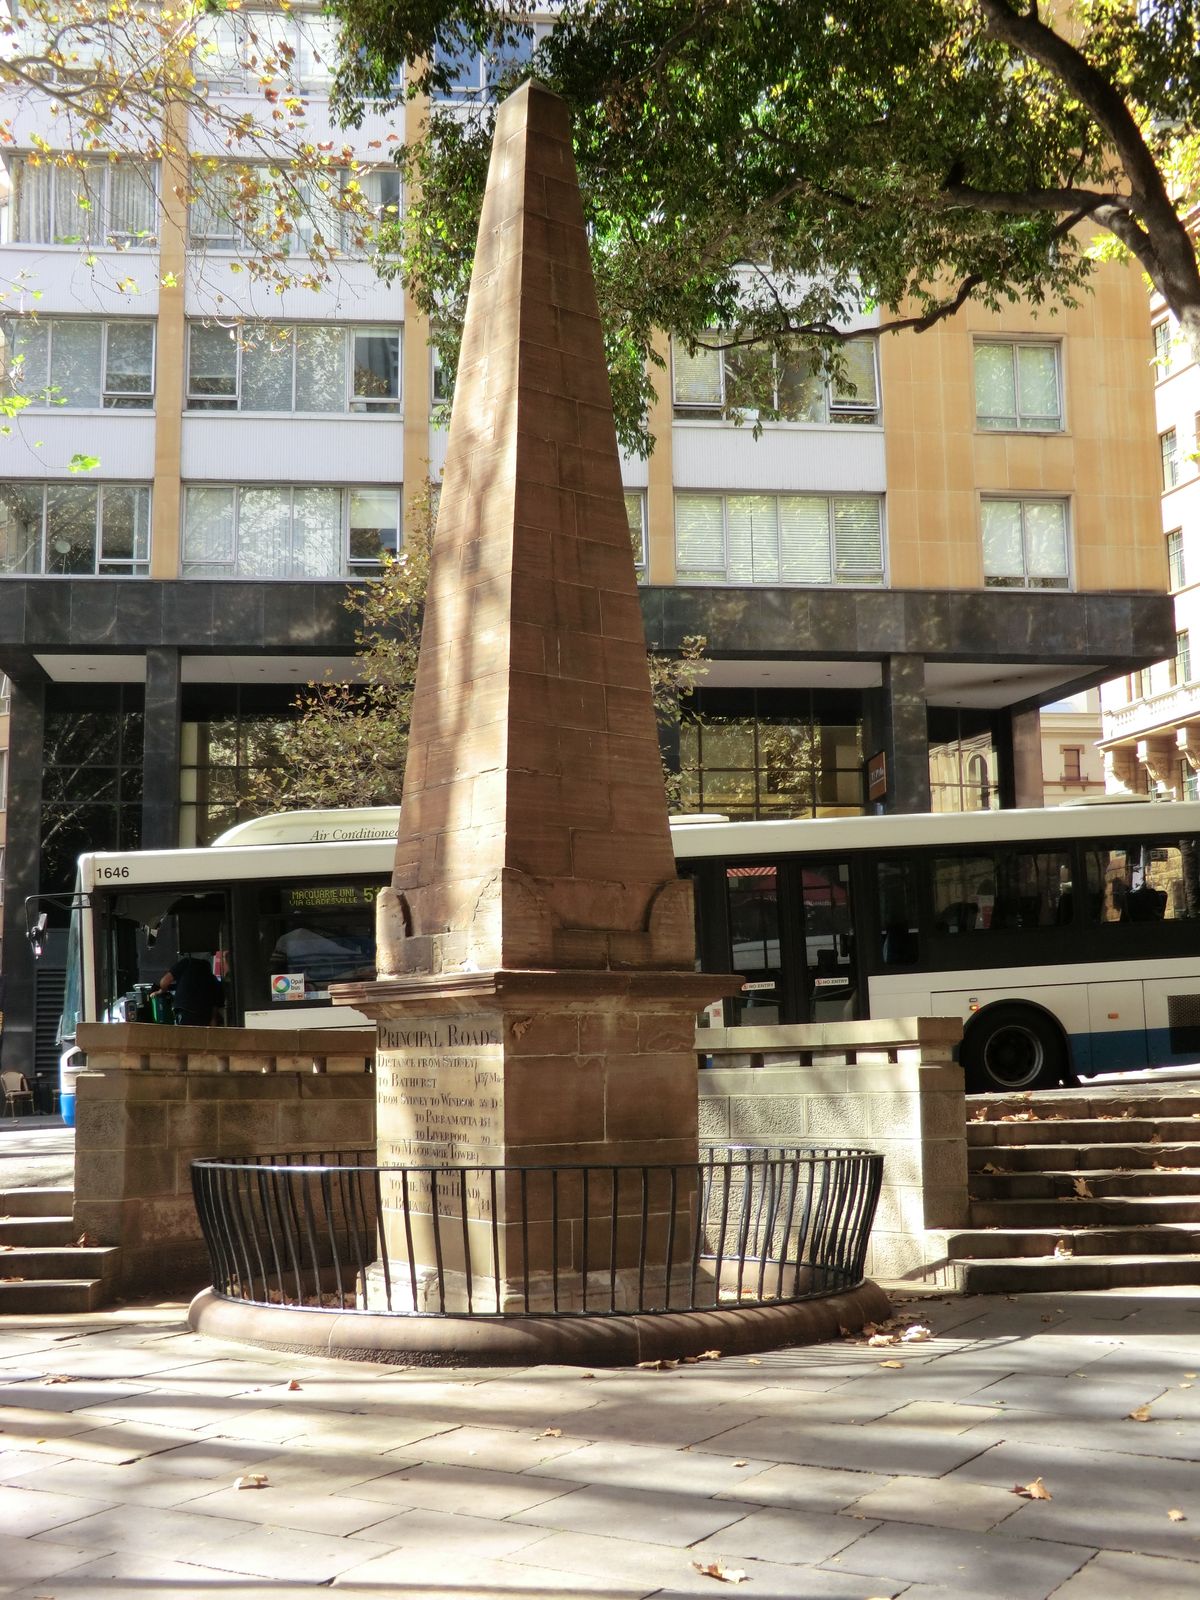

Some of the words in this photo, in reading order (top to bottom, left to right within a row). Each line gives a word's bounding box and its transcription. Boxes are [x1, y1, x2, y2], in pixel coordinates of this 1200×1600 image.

[309, 829, 330, 841] Air
[96, 866, 130, 879] 1646
[291, 889, 338, 900] MACQUARIE
[377, 1026, 443, 1048] PRINCIPAL
[377, 1053, 416, 1067] DISTANCE
[417, 1057, 441, 1068] FROM
[442, 1055, 474, 1068] SYDNEY
[391, 1072, 437, 1088] BATHURST
[378, 1091, 398, 1104] FROM
[430, 1097, 440, 1106] TO
[440, 1092, 475, 1108] WINDSOR
[415, 1113, 425, 1123] TO
[426, 1109, 477, 1126] PARRAMATTA
[415, 1130, 425, 1140] TO
[426, 1126, 470, 1143] LIVERPOOL
[390, 1144, 401, 1155] TO
[447, 1142, 476, 1160] TOWER
[419, 1180, 449, 1195] NOTH
[451, 1181, 478, 1199] HAD
